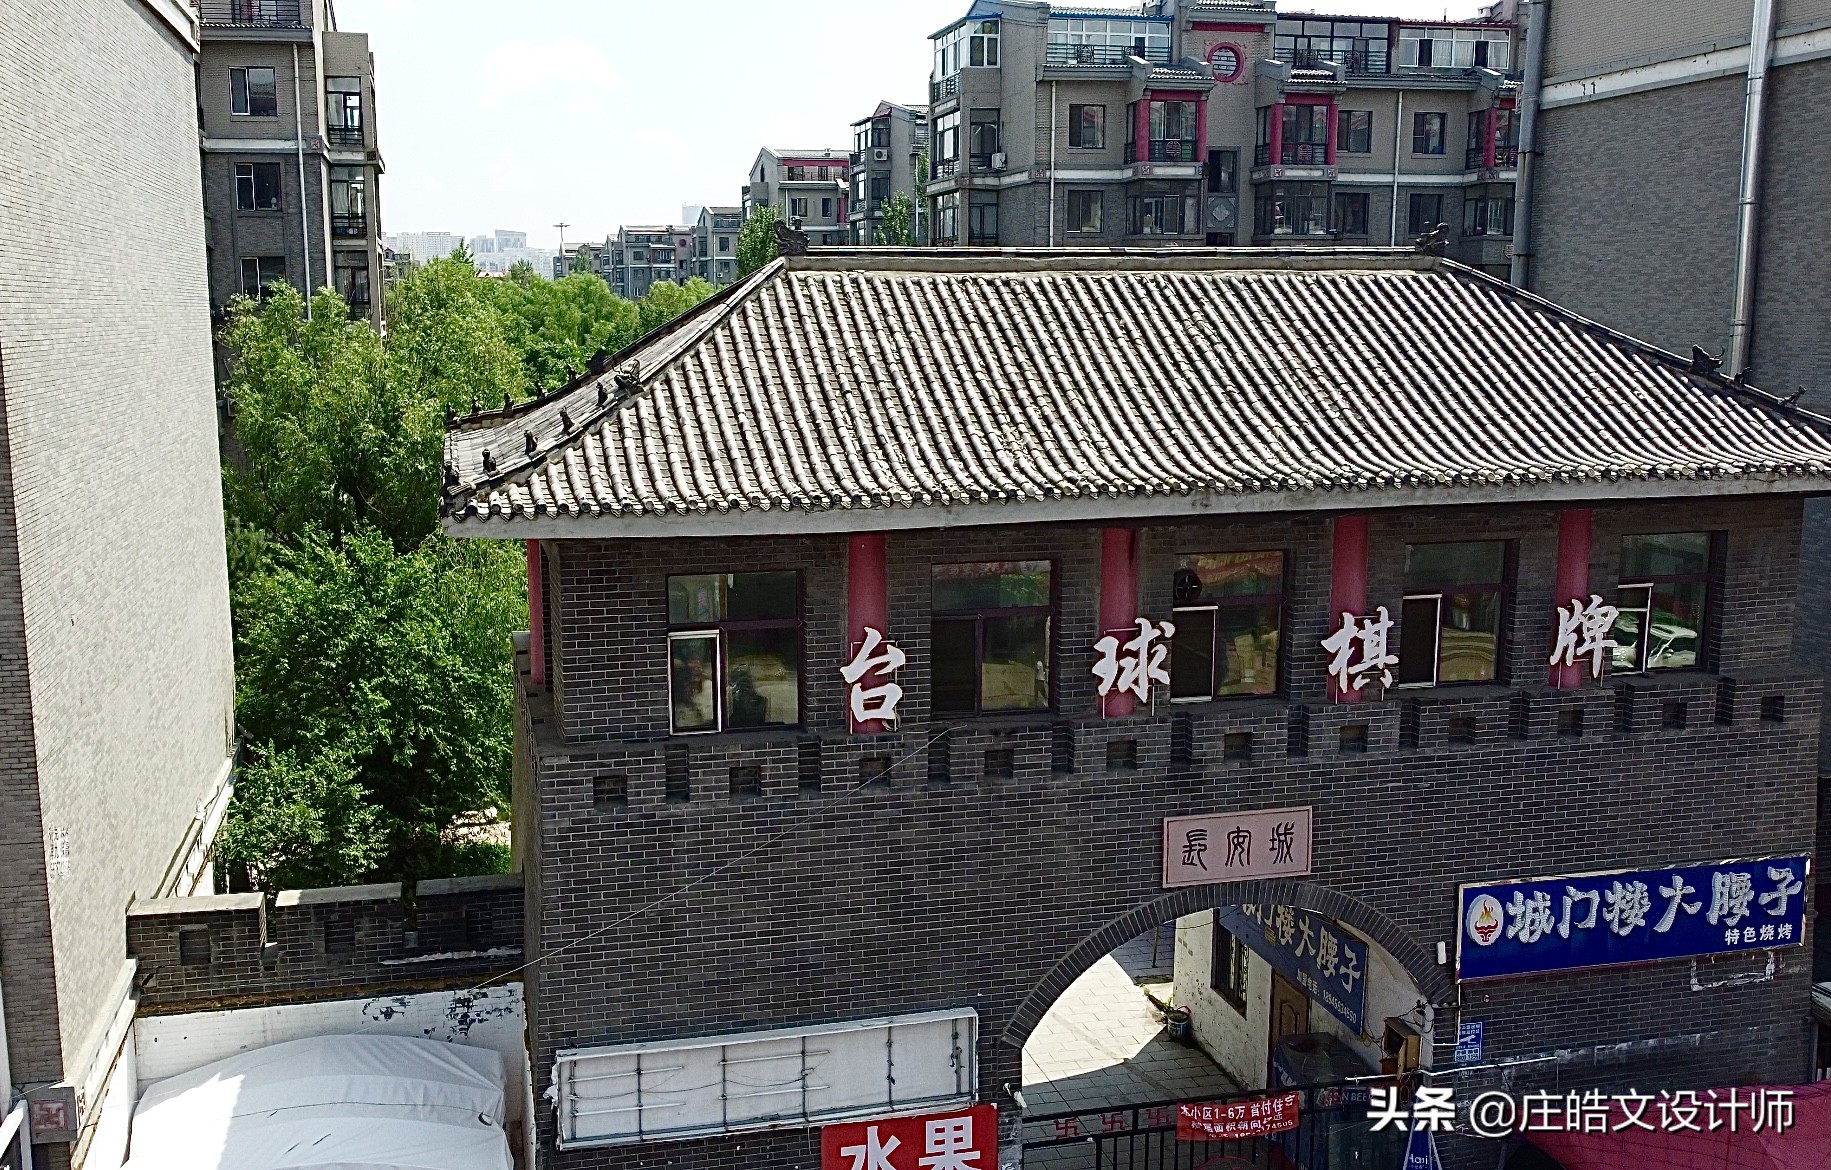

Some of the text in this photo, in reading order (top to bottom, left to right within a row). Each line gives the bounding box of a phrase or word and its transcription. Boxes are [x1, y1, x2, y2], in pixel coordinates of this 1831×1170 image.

[840, 594, 1619, 722] 台球棋牌
[1505, 866, 1803, 943] 城门楼大腰子
[1724, 923, 1793, 945] 特色烧烤
[841, 1116, 982, 1170] 水果
